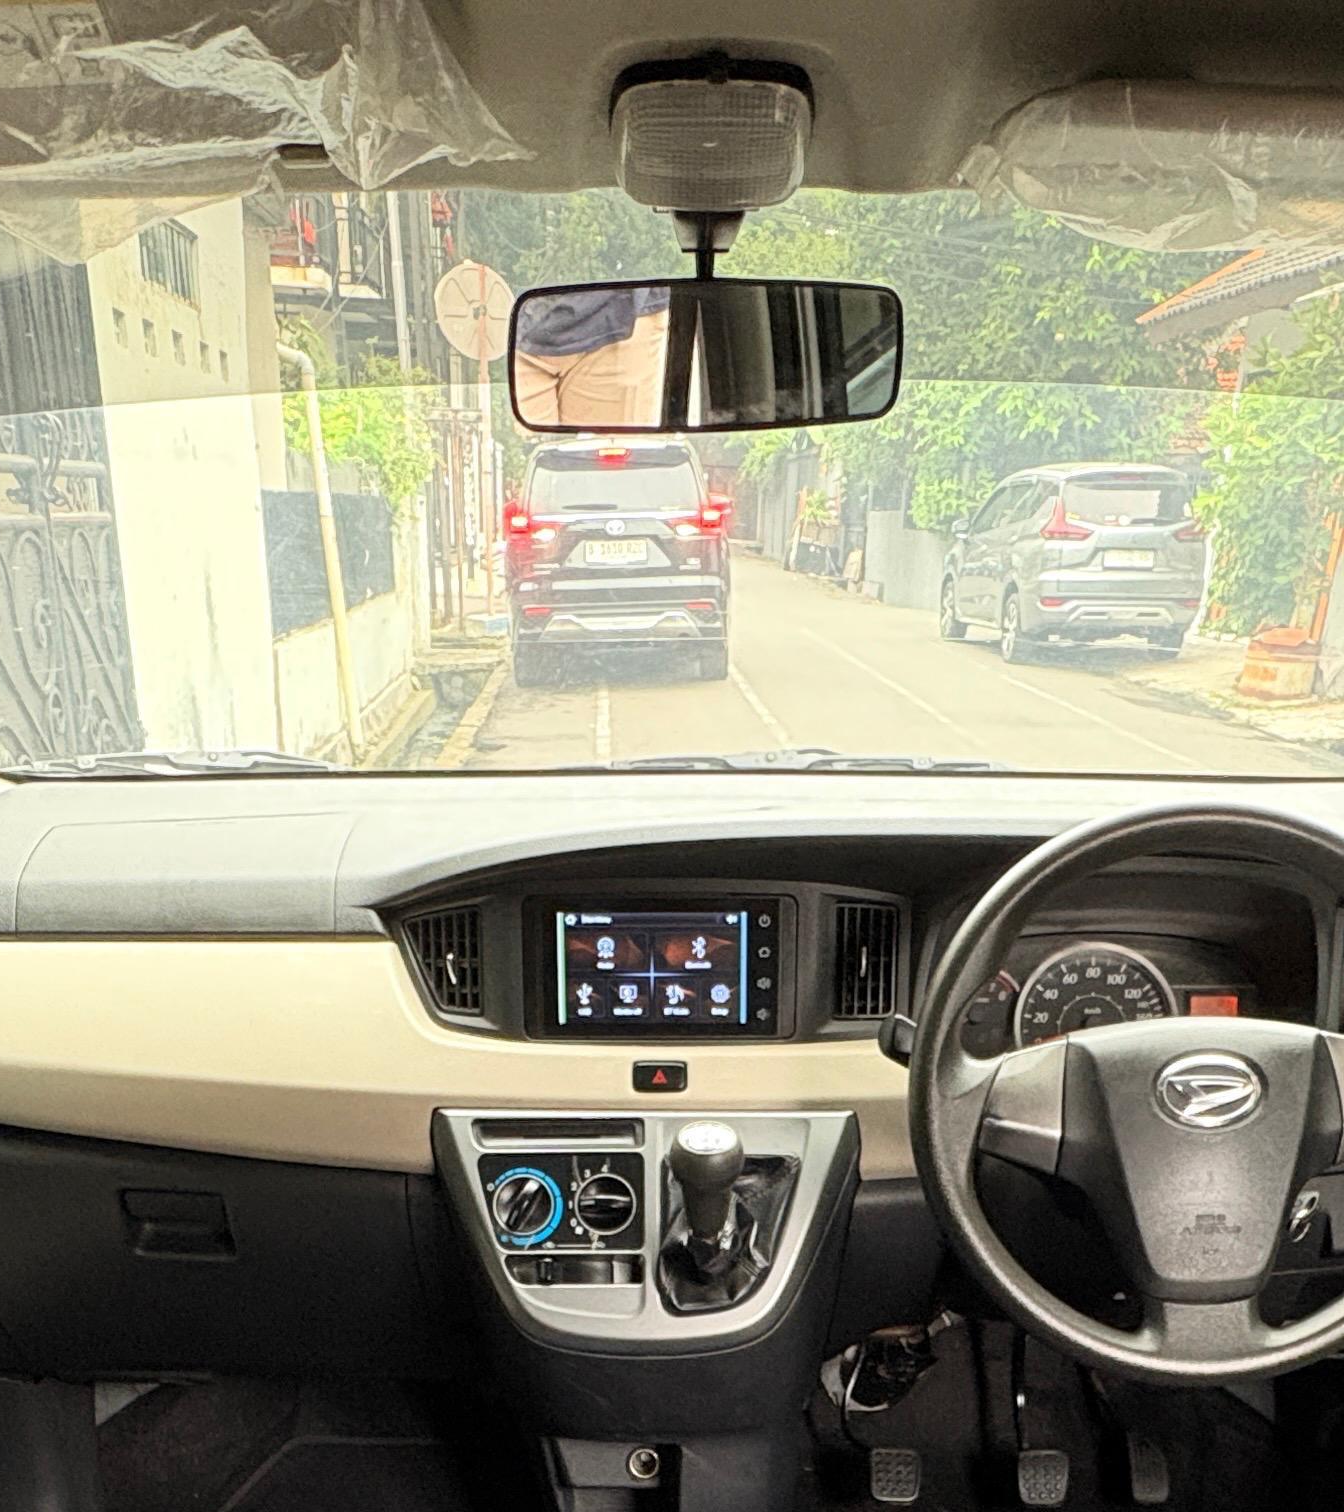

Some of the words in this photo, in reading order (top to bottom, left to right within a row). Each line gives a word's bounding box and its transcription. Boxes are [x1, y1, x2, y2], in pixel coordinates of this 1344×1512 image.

[1085, 967, 1101, 979] 80
[1063, 973, 1078, 985] 60
[1106, 974, 1127, 985] 100
[1043, 989, 1058, 1000] 40
[1124, 988, 1142, 999] 120
[1032, 1012, 1049, 1024] 20
[584, 1169, 591, 1178] 3
[601, 1164, 609, 1173] 4
